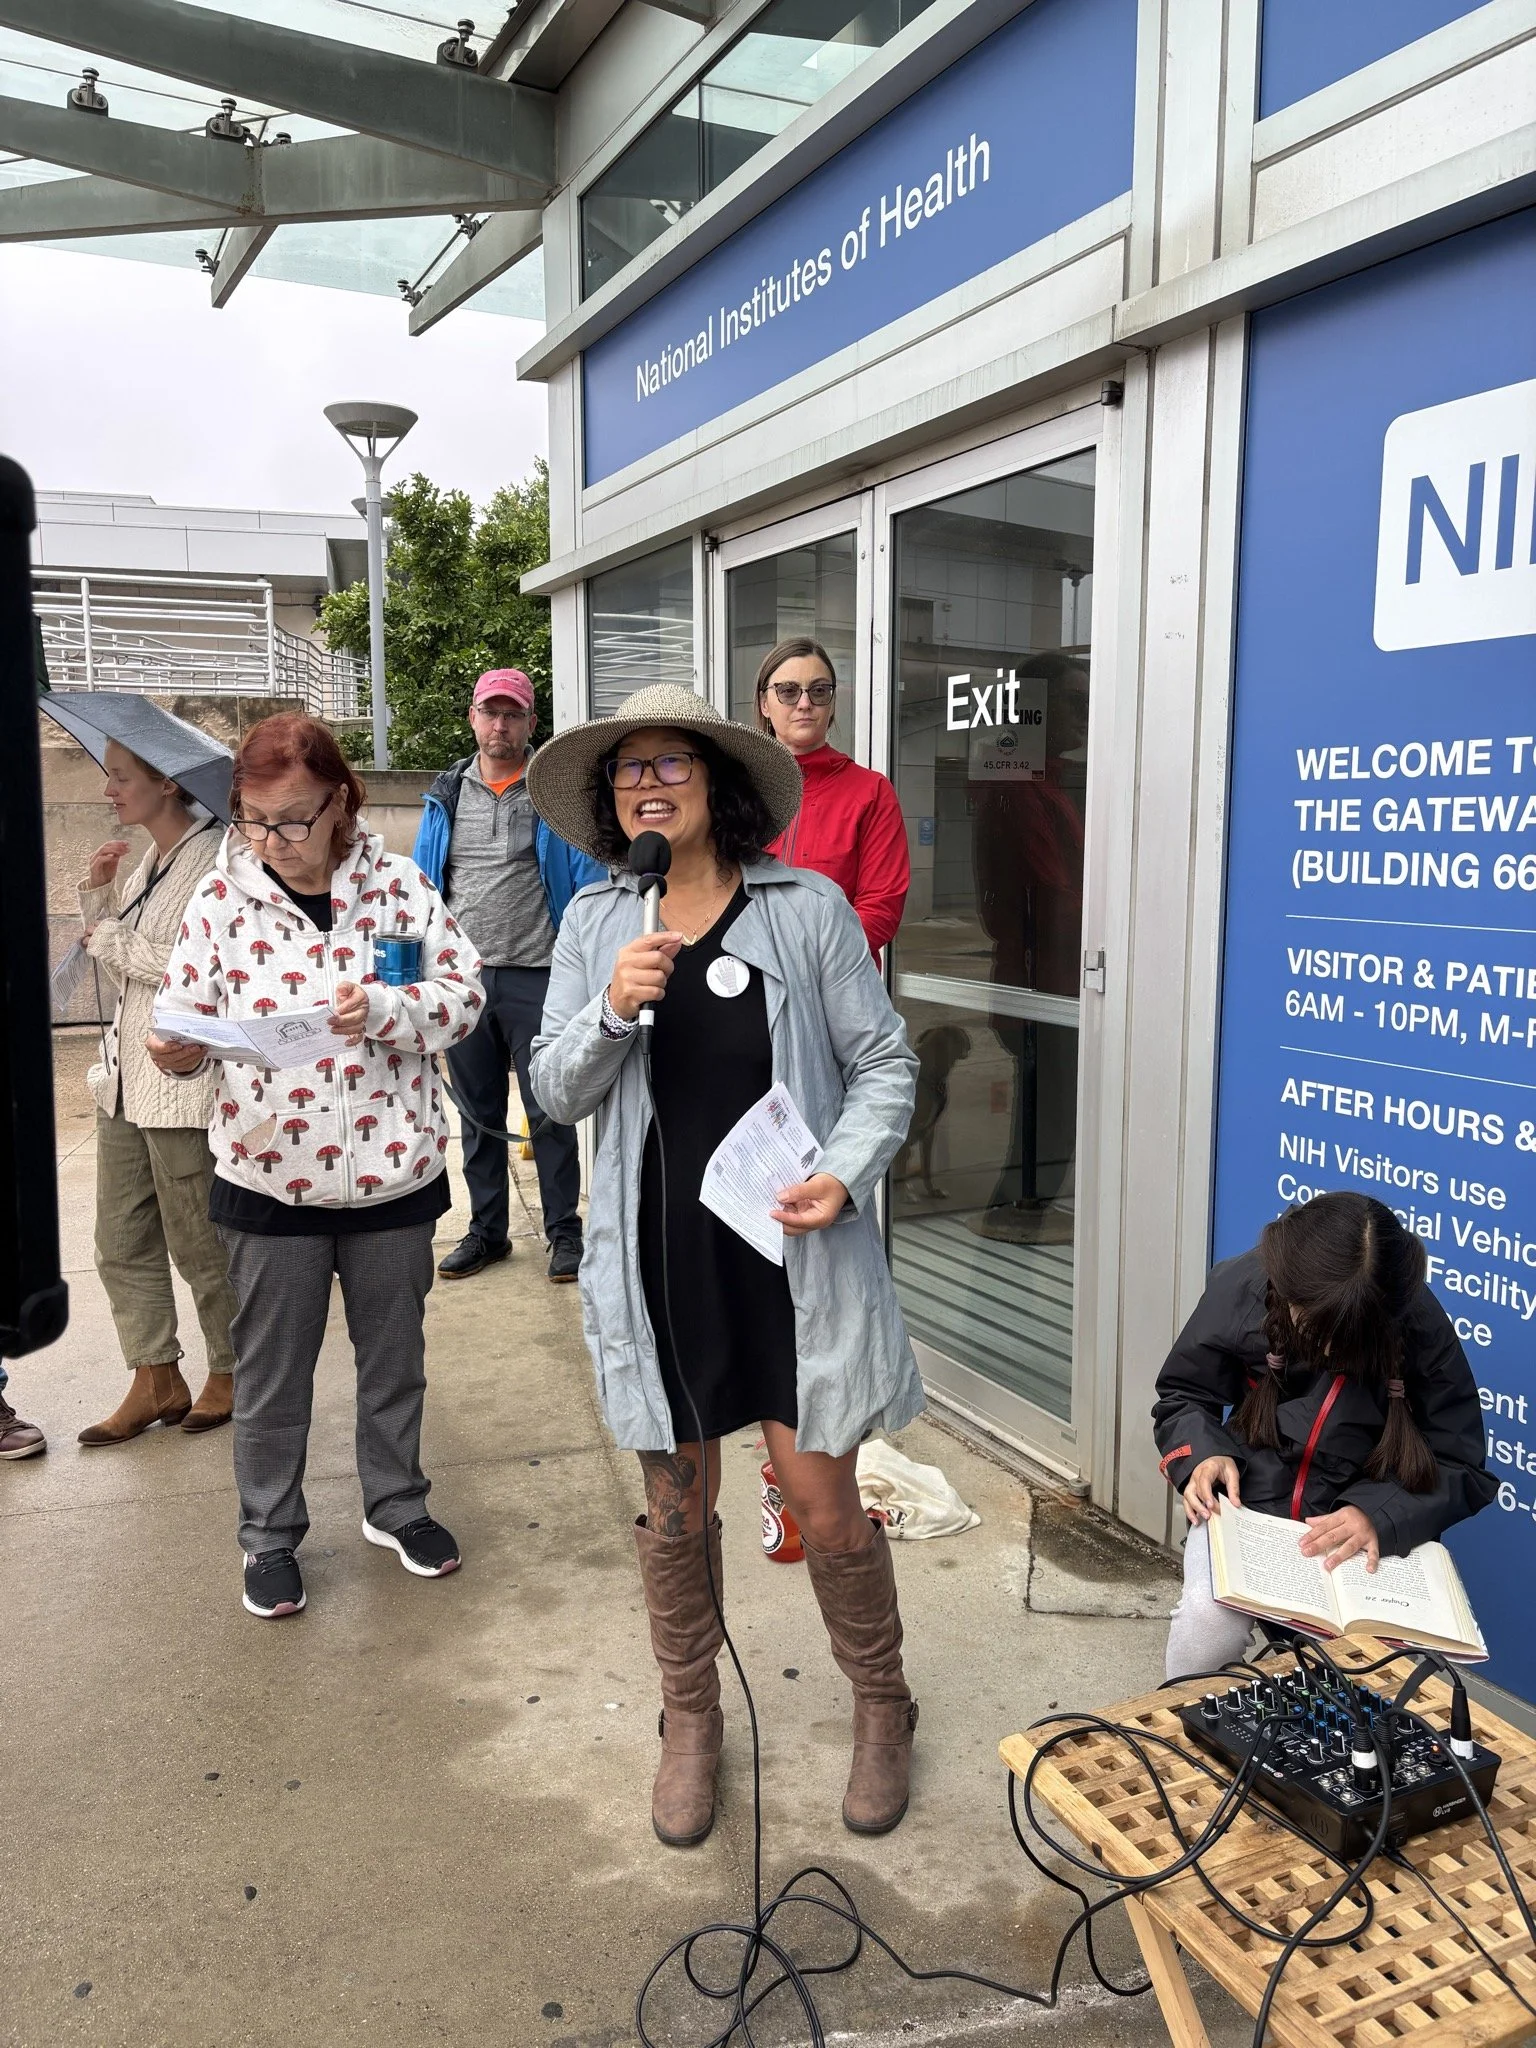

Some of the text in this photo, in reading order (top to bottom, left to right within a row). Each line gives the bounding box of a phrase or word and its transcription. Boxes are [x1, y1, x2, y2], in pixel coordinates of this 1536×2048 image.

[636, 132, 991, 403] National Institutes of Health
[1404, 452, 1536, 586] NI
[946, 667, 1021, 731] Exit
[1296, 735, 1536, 781] WELCOME T
[1294, 798, 1362, 832] THE
[1292, 849, 1536, 891] (BUILDING 66
[1287, 947, 1404, 986] VISITOR
[1413, 958, 1436, 989] &
[1285, 989, 1345, 1023] 6AM
[1374, 1000, 1468, 1045] 10PM,
[1280, 1077, 1536, 1153] AFTER HOURS &
[1279, 1132, 1508, 1211] NIH Visitors use
[1451, 1215, 1536, 1268] Vehic
[1425, 1254, 1536, 1321] Facility
[1497, 1481, 1536, 1522] 6-
